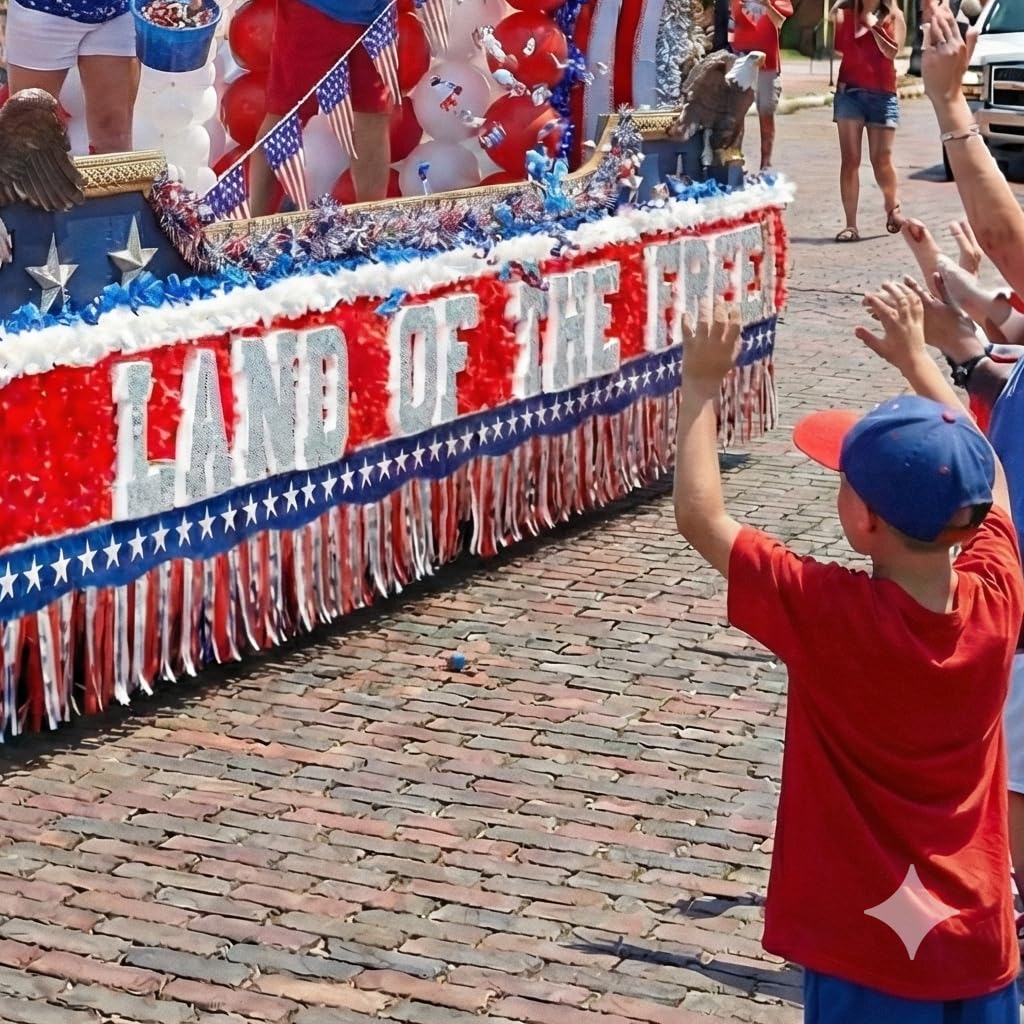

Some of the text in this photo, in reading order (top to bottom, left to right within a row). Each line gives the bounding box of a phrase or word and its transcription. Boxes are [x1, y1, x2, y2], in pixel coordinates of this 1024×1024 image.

[111, 325, 350, 521] LAND
[388, 293, 479, 437] OF
[505, 262, 621, 398] THE
